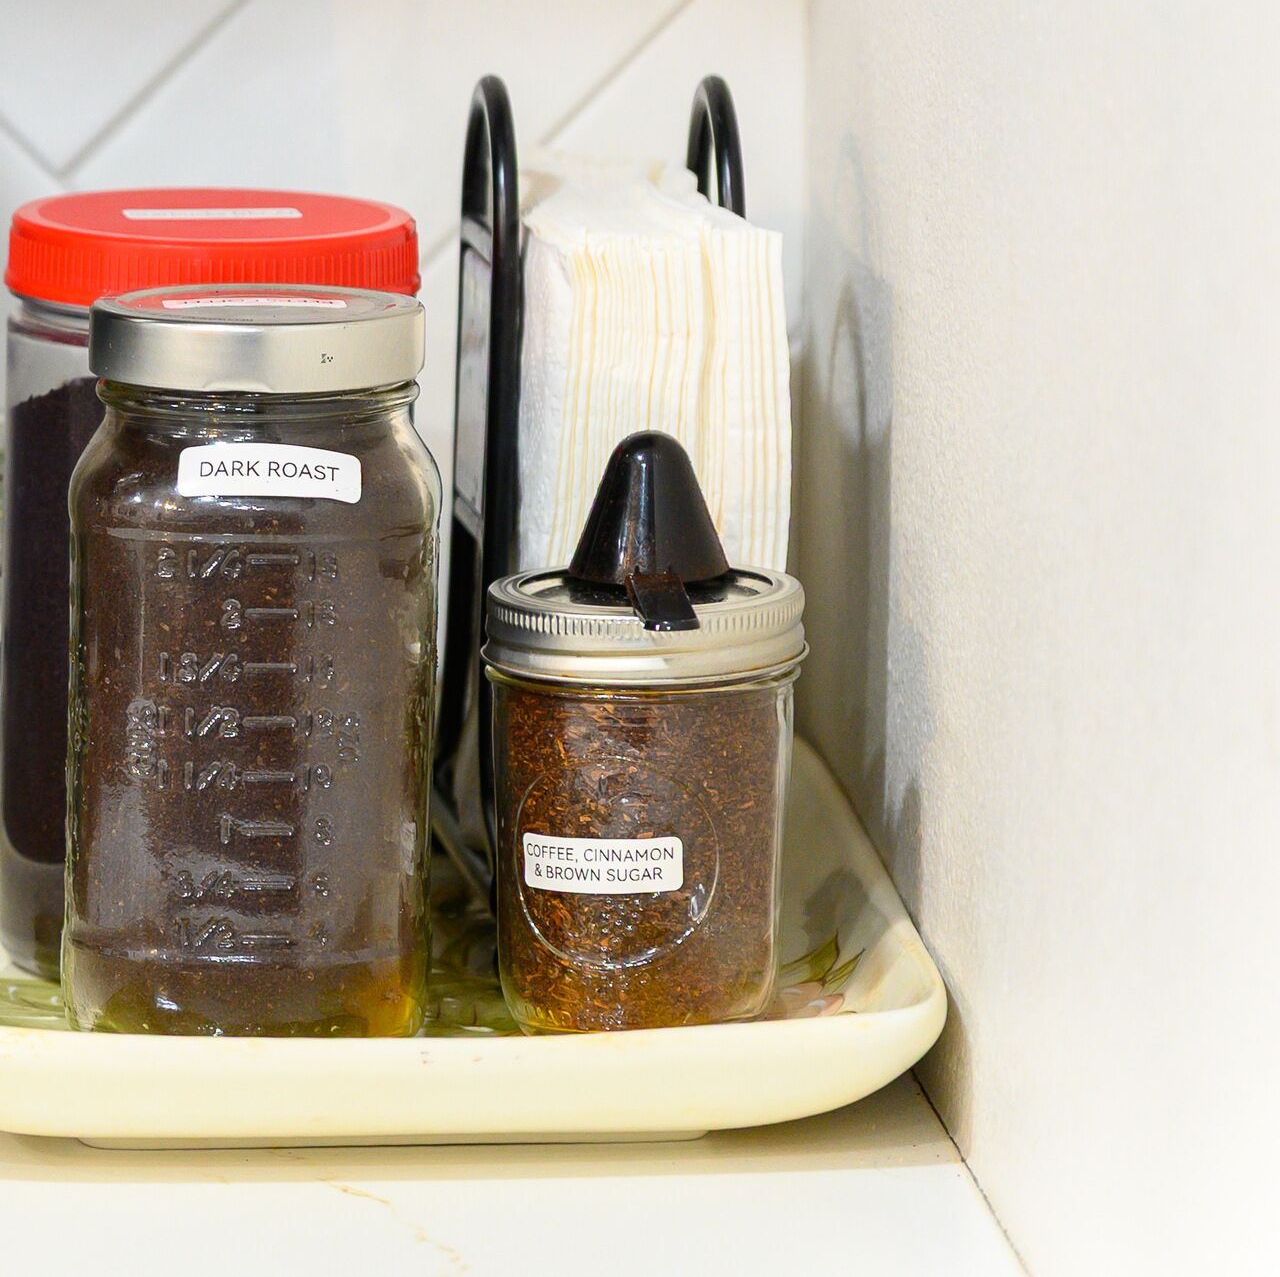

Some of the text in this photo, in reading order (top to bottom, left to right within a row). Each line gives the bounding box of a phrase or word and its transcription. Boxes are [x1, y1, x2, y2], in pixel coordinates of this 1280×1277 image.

[199, 460, 340, 482] DARK ROAST
[527, 843, 674, 863] COFFEE, CINNAMON
[534, 863, 663, 882] & BROWN SUGAR
